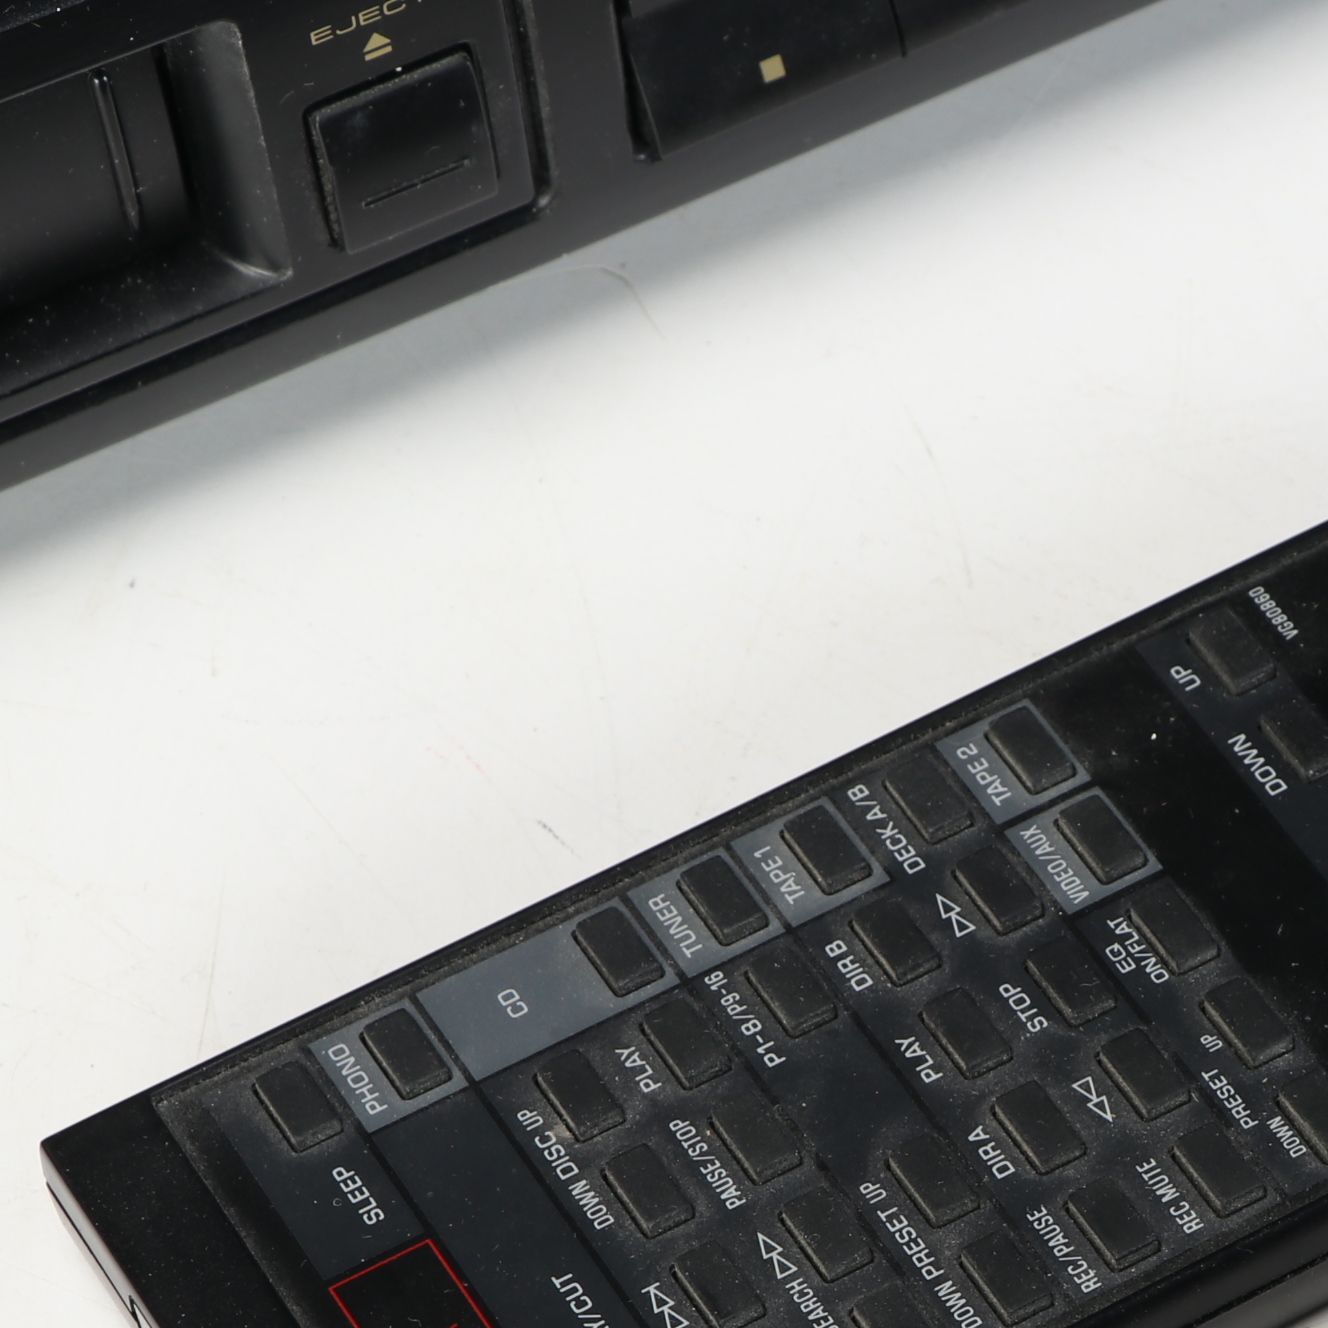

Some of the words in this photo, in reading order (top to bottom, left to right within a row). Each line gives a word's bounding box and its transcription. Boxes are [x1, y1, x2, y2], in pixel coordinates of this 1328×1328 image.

[310, 0, 421, 45] EJEC
[1248, 586, 1299, 640] VG80860
[1170, 665, 1201, 692] UP
[956, 743, 978, 761] 2
[1228, 733, 1288, 797] DOWN
[847, 784, 886, 822] A/B
[968, 763, 1012, 806] TAPE
[753, 846, 771, 859] 1
[875, 824, 926, 875] DECK
[1019, 824, 1090, 904] VIDEO/AUX
[760, 859, 806, 904] TAPE
[648, 894, 703, 958] TUNER
[824, 940, 848, 958] B
[1104, 943, 1137, 974] EQ
[1107, 916, 1170, 985] ON/FLAT
[836, 956, 874, 992] DIR
[497, 988, 529, 1019] CD
[704, 971, 786, 1068] P1-8/P9-16
[999, 984, 1048, 1033] STOP
[895, 1037, 943, 1084] PLAY
[1200, 1034, 1223, 1052] UP
[327, 1043, 389, 1116] PHONO
[615, 1046, 662, 1094] PLAY
[517, 1109, 544, 1131] UP
[1201, 1069, 1259, 1129] PRESET
[535, 1131, 579, 1180] DISC
[967, 1125, 987, 1142] A
[1266, 1117, 1307, 1158] DOWN
[669, 1119, 747, 1211] PAUSE/STOP
[977, 1144, 1016, 1180] DIR
[1135, 1157, 1179, 1203] MUTE
[332, 1166, 385, 1226] SLEEP
[567, 1178, 615, 1231] DOWN
[859, 1181, 886, 1204] UP
[1169, 1201, 1205, 1235] REC
[877, 1207, 944, 1281] PRESET
[1026, 1204, 1102, 1294] REC/PAUSE
